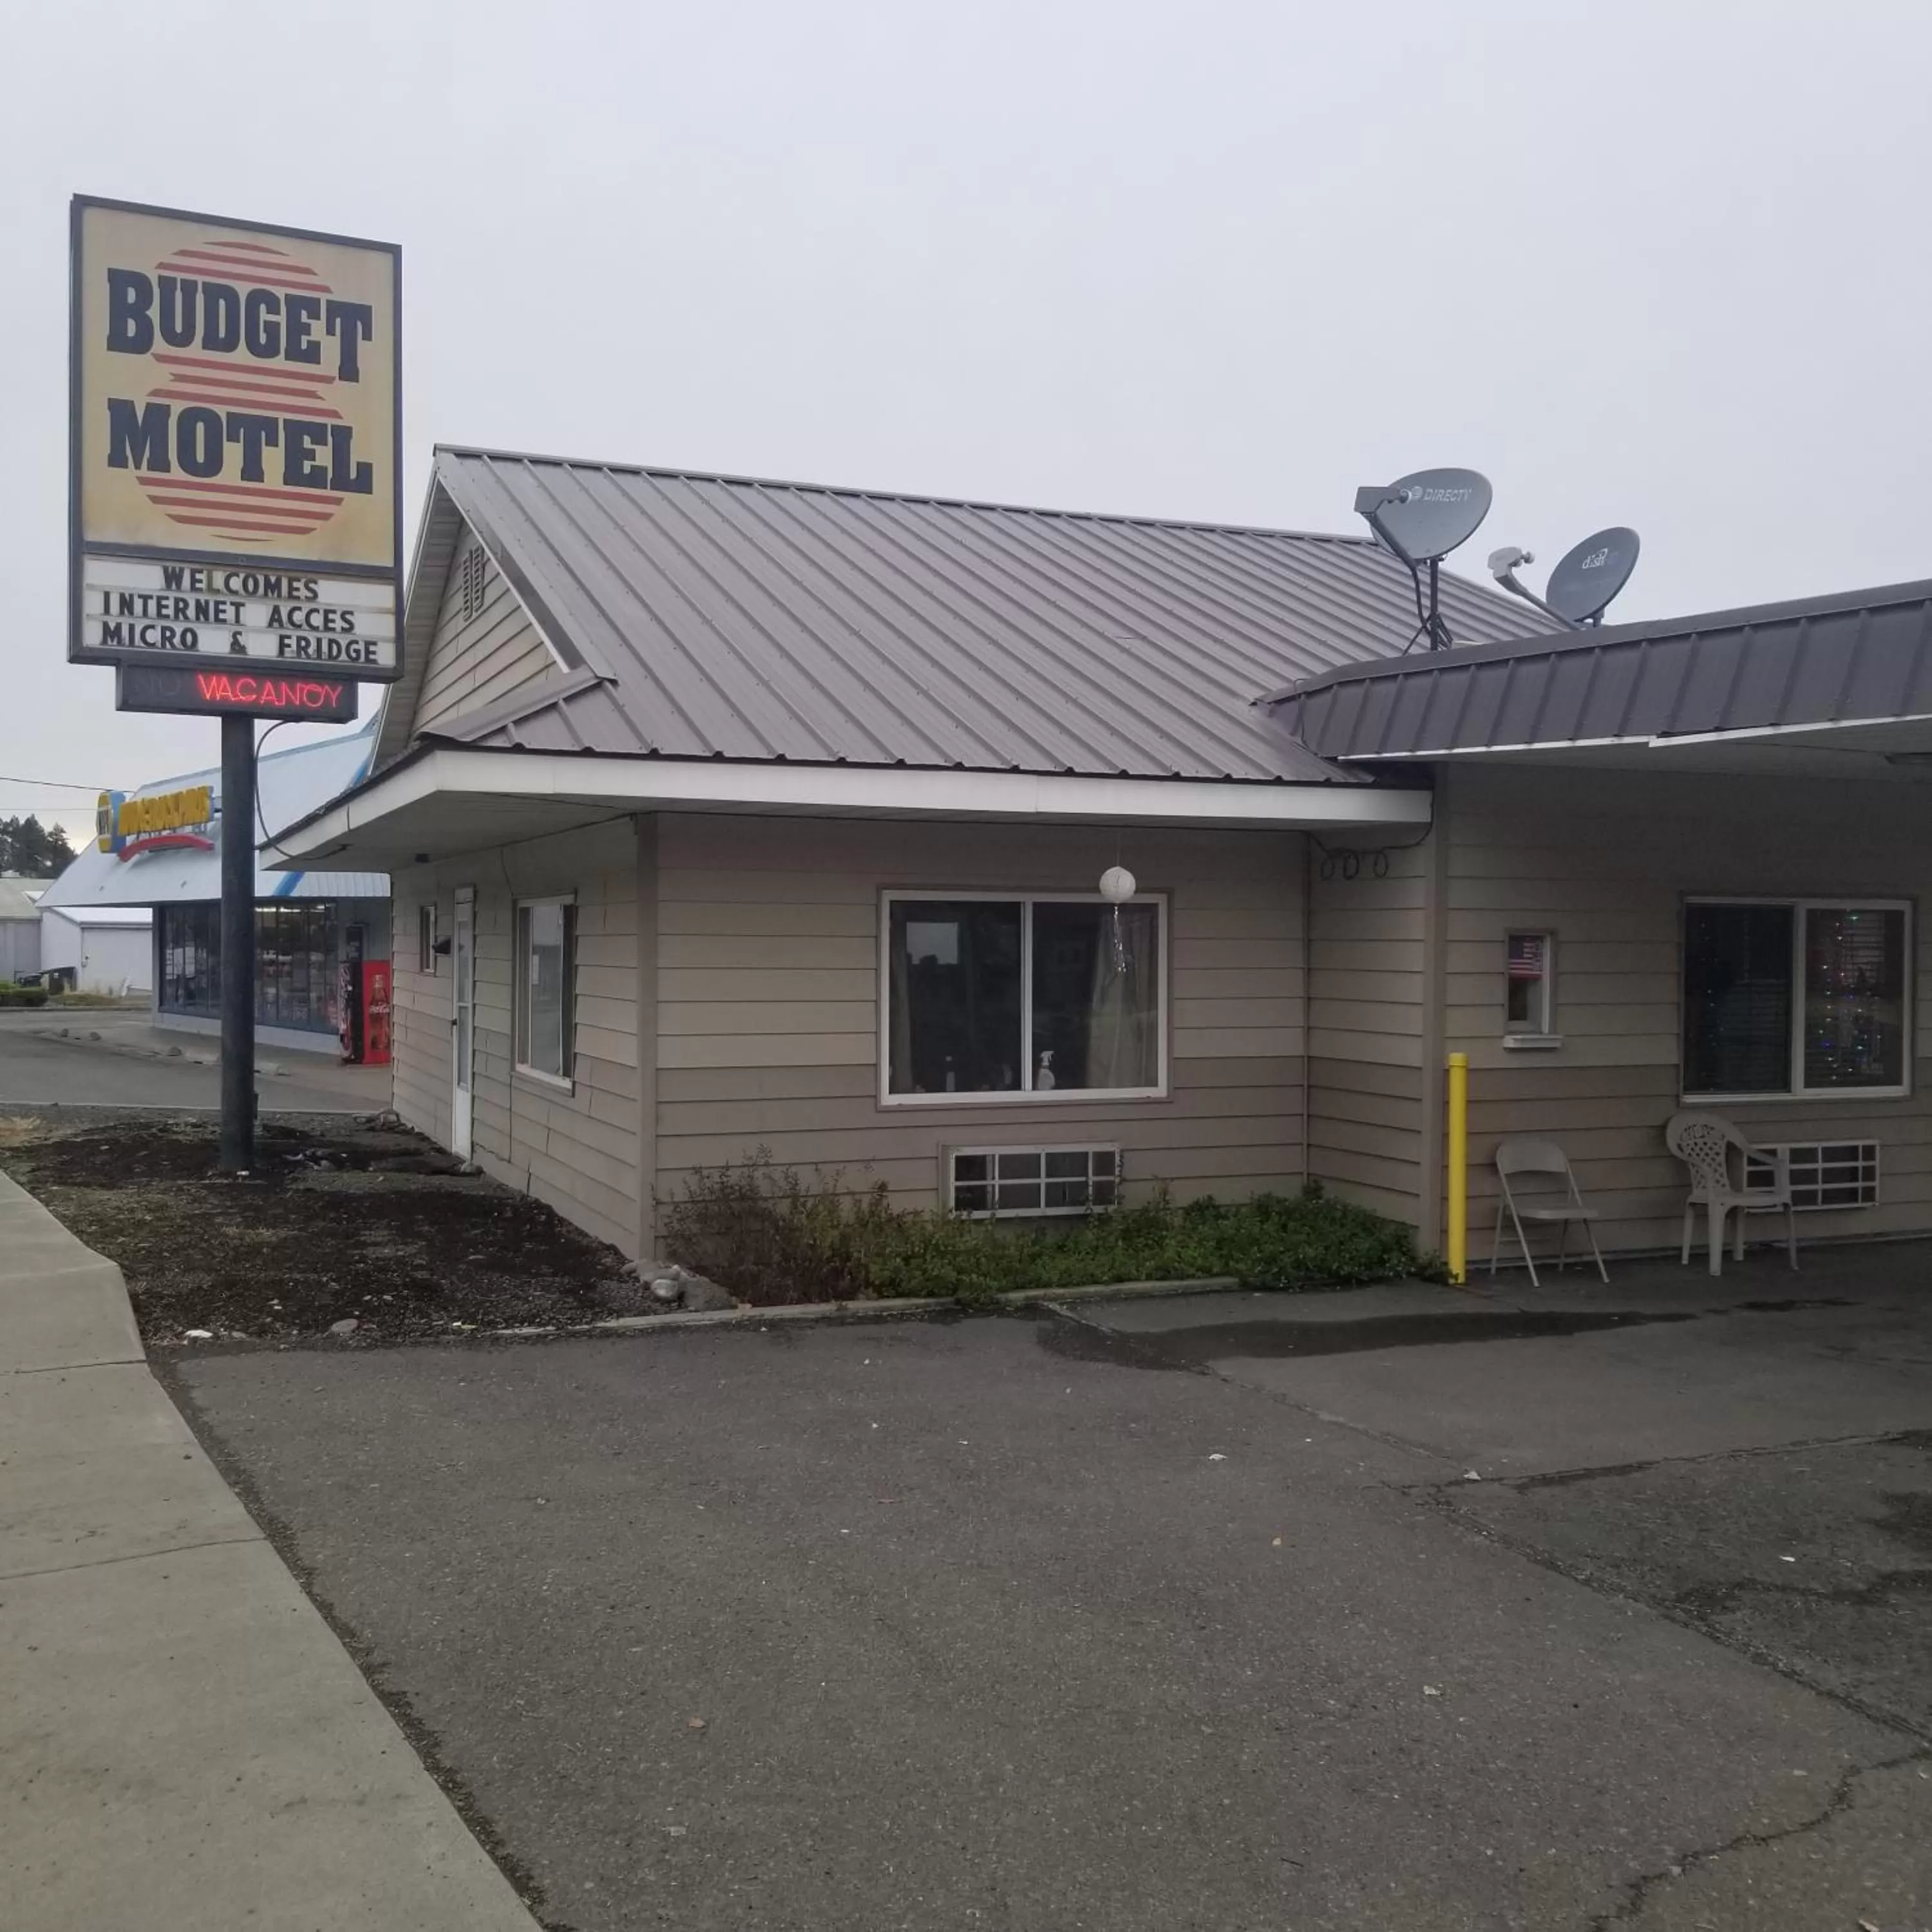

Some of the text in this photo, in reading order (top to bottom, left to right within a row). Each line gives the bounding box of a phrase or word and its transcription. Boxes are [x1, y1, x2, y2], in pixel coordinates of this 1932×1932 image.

[106, 267, 373, 383] BUDGET
[107, 397, 374, 495] MOTEL
[1582, 548, 1608, 569] dish
[162, 565, 319, 601] WELCOMES
[103, 591, 355, 633] INTERNET ACCES
[101, 620, 379, 665] MICRO & FRIDGE
